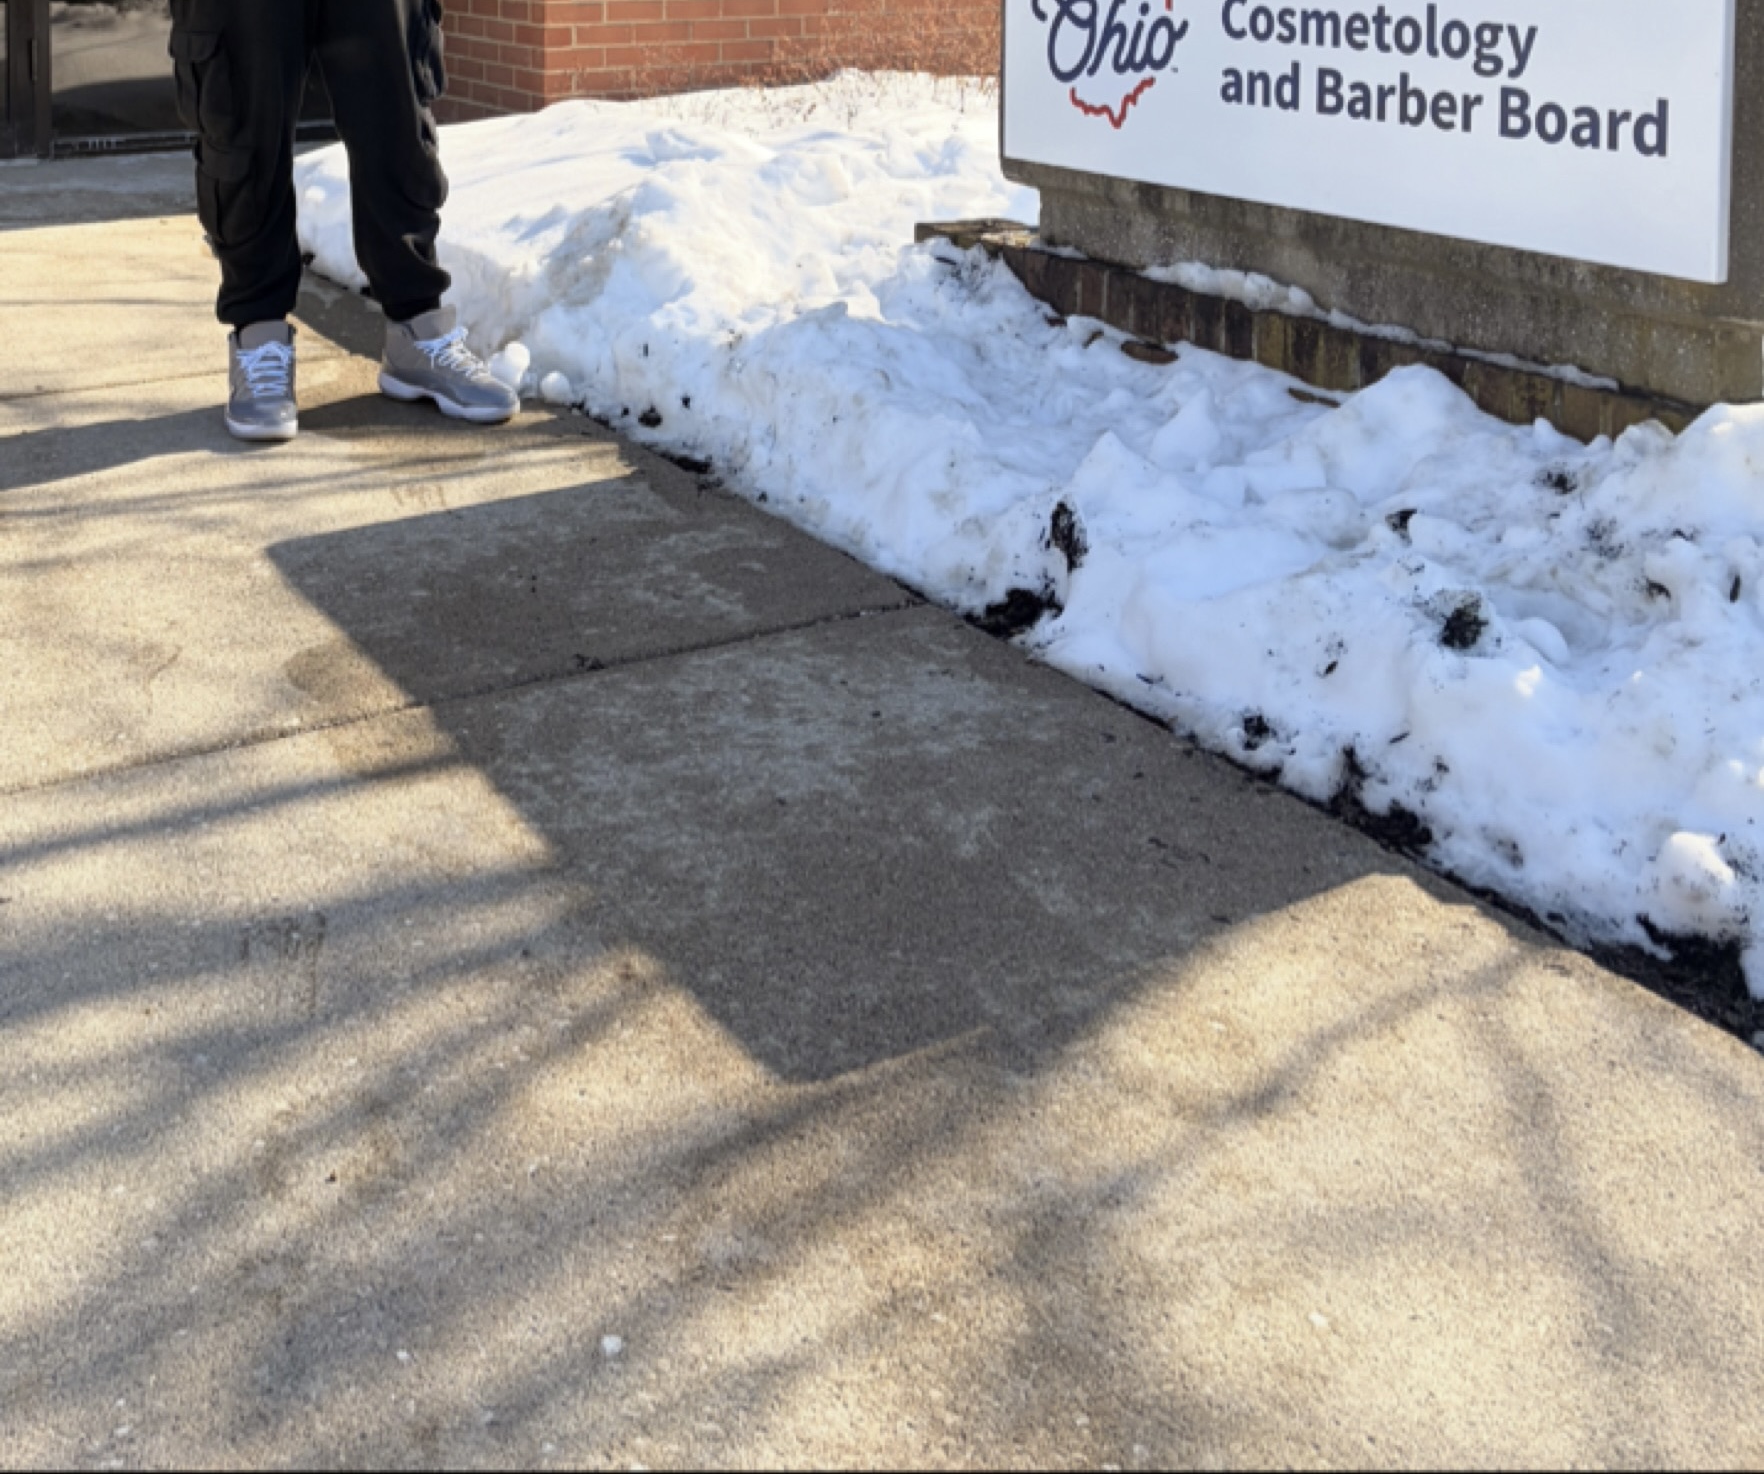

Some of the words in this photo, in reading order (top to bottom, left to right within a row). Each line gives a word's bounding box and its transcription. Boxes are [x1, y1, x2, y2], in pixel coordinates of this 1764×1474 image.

[1219, 60, 1300, 111] and
[1315, 67, 1484, 133] Barber
[1499, 86, 1669, 157] Board
